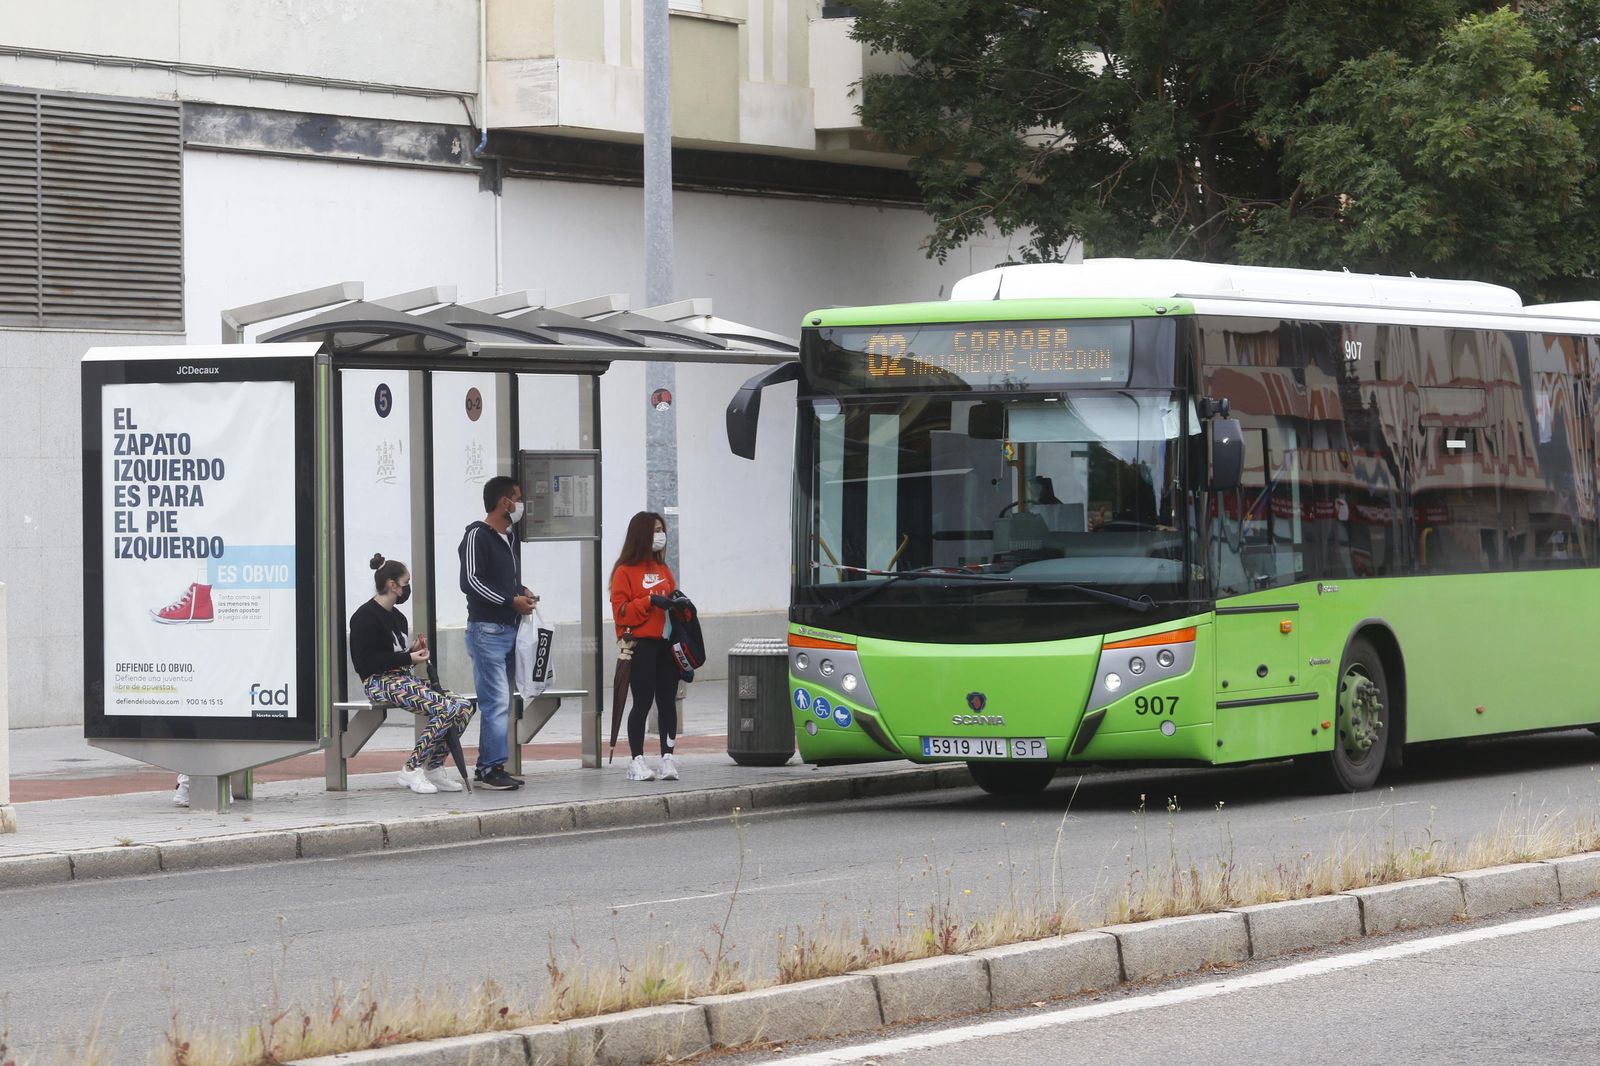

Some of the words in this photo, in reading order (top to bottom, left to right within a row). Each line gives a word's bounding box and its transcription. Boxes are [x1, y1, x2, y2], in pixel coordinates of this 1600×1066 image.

[954, 328, 1068, 352] CORDOBA
[1344, 340, 1362, 361] 907
[176, 365, 220, 375] JCDecaux
[379, 390, 388, 411] 5
[113, 407, 138, 430] EL
[113, 432, 191, 456] ZAPATO
[113, 458, 225, 483] IZQUIERDO
[114, 484, 140, 507] ES
[147, 484, 205, 507] PARA
[114, 510, 138, 533] EL
[146, 510, 178, 533] PIE
[114, 535, 225, 561] IZQUIERDO
[217, 564, 238, 584] ES
[242, 564, 289, 584] OBVIO
[535, 632, 548, 677] BOSSI
[675, 650, 690, 669] FILA
[115, 662, 154, 673] DEFIENDE
[156, 662, 167, 673] LO
[168, 662, 195, 673] OBVIO.
[115, 674, 147, 682] Defiende
[162, 674, 193, 683] juventud
[249, 683, 288, 706] fad
[1134, 695, 1180, 716] 907
[952, 714, 1006, 726] SCANIA
[932, 739, 970, 754] 5919
[976, 740, 1004, 756] JVL
